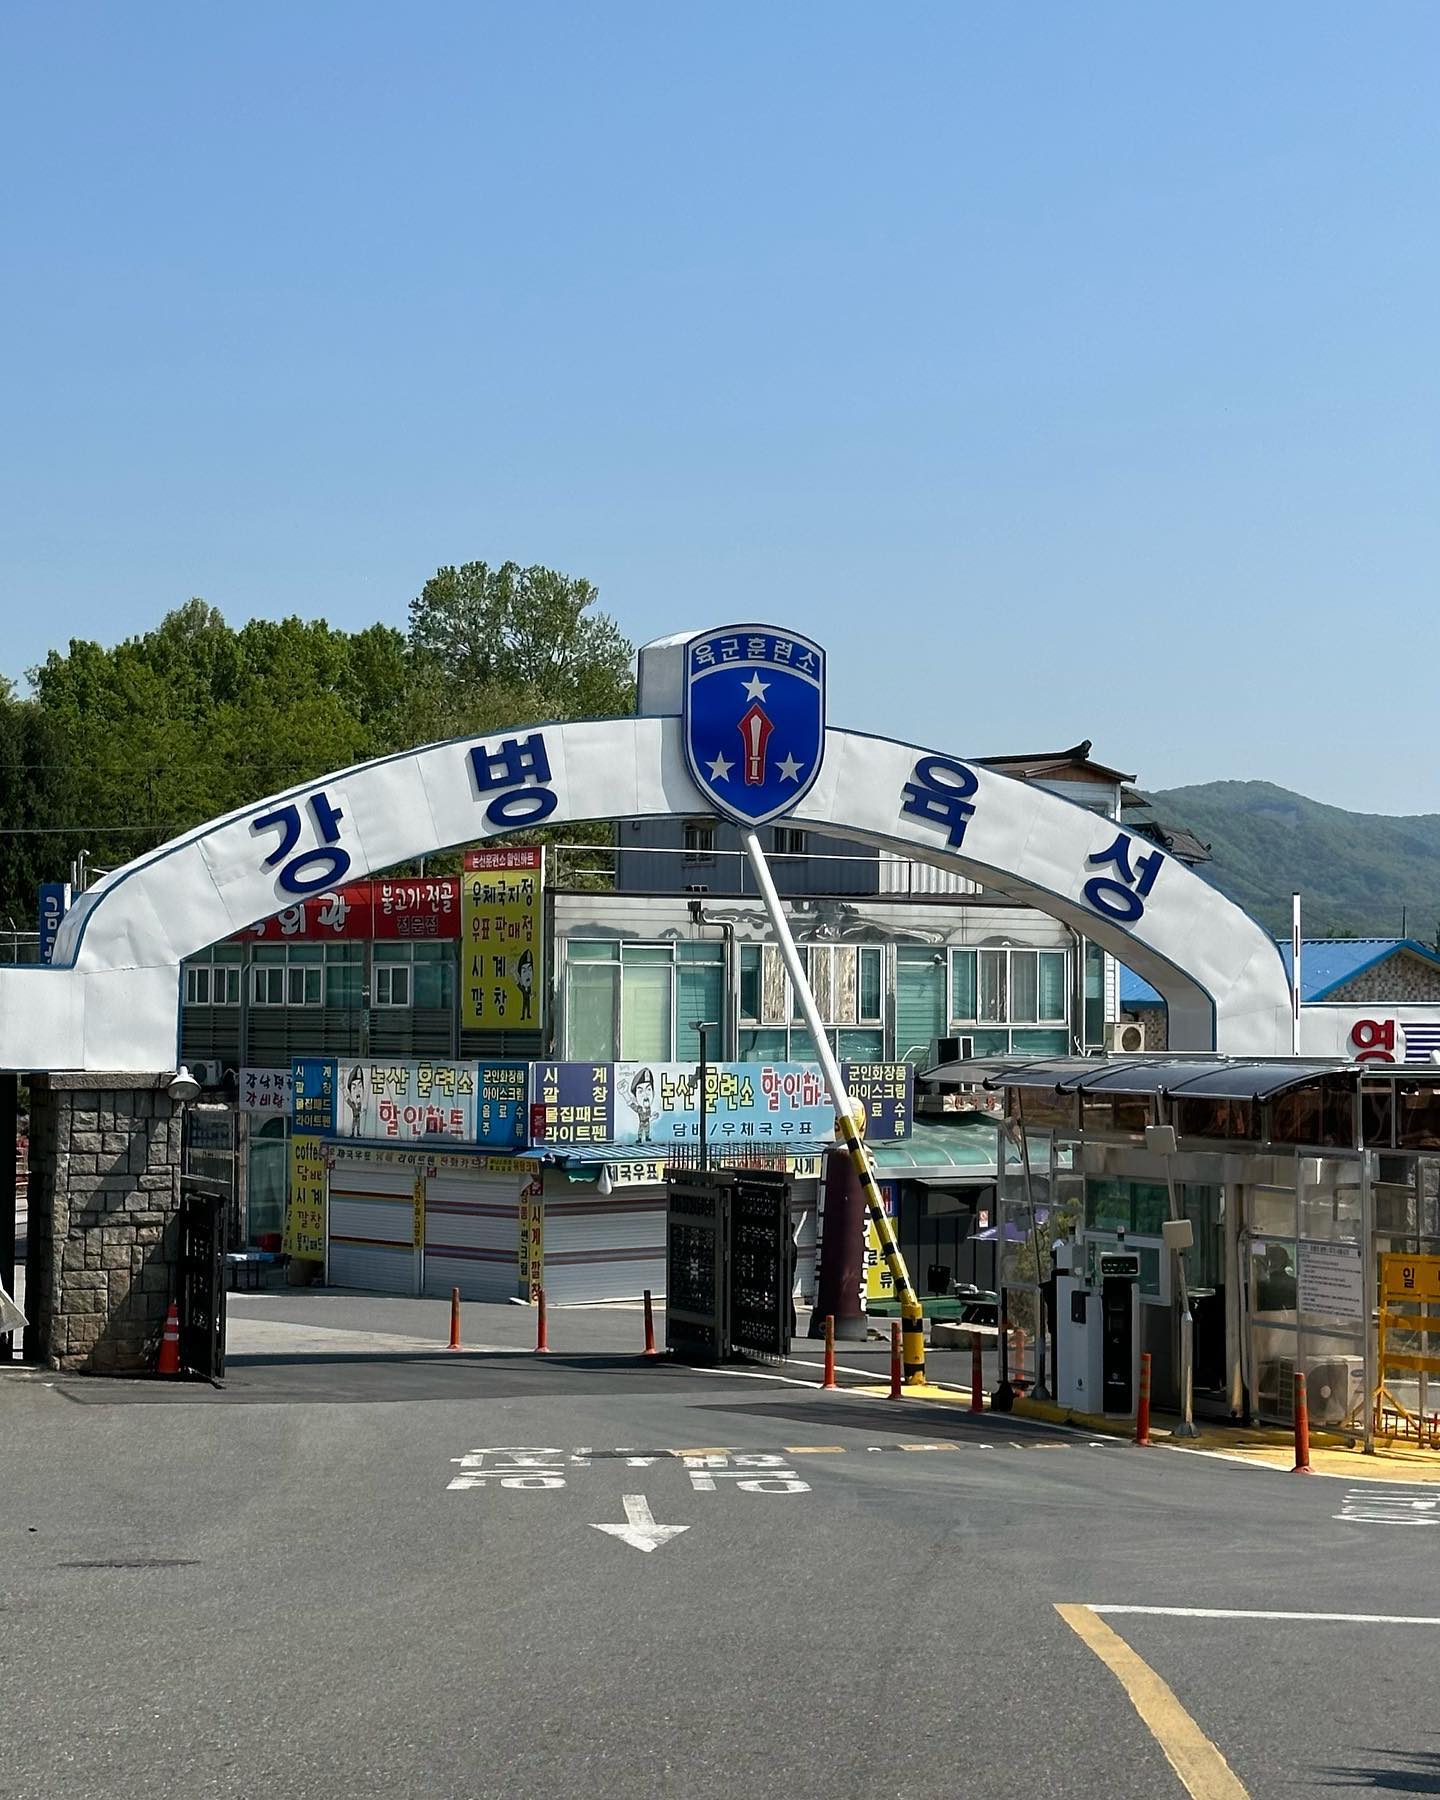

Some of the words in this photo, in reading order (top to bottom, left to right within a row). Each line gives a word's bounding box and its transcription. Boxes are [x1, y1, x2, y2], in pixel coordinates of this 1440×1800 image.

[695, 637, 816, 675] 육군훈련소
[251, 791, 351, 894] 강
[469, 732, 559, 827] 병
[903, 755, 979, 849] 육
[1083, 832, 1166, 922] 성
[472, 878, 533, 907] 우체국지정
[472, 916, 490, 943] 우표
[494, 915, 533, 942] 판매점
[370, 1064, 410, 1095] 논산
[416, 1061, 474, 1098] 훈련소
[848, 1064, 906, 1081] 군인화장품
[482, 1087, 525, 1102] 아이스크림
[661, 1072, 698, 1111] 논산
[704, 1066, 755, 1114] 훈련소
[848, 1083, 906, 1100] 아이스크림
[379, 1100, 465, 1136] 할인마트
[543, 1124, 608, 1142] 라이트펜
